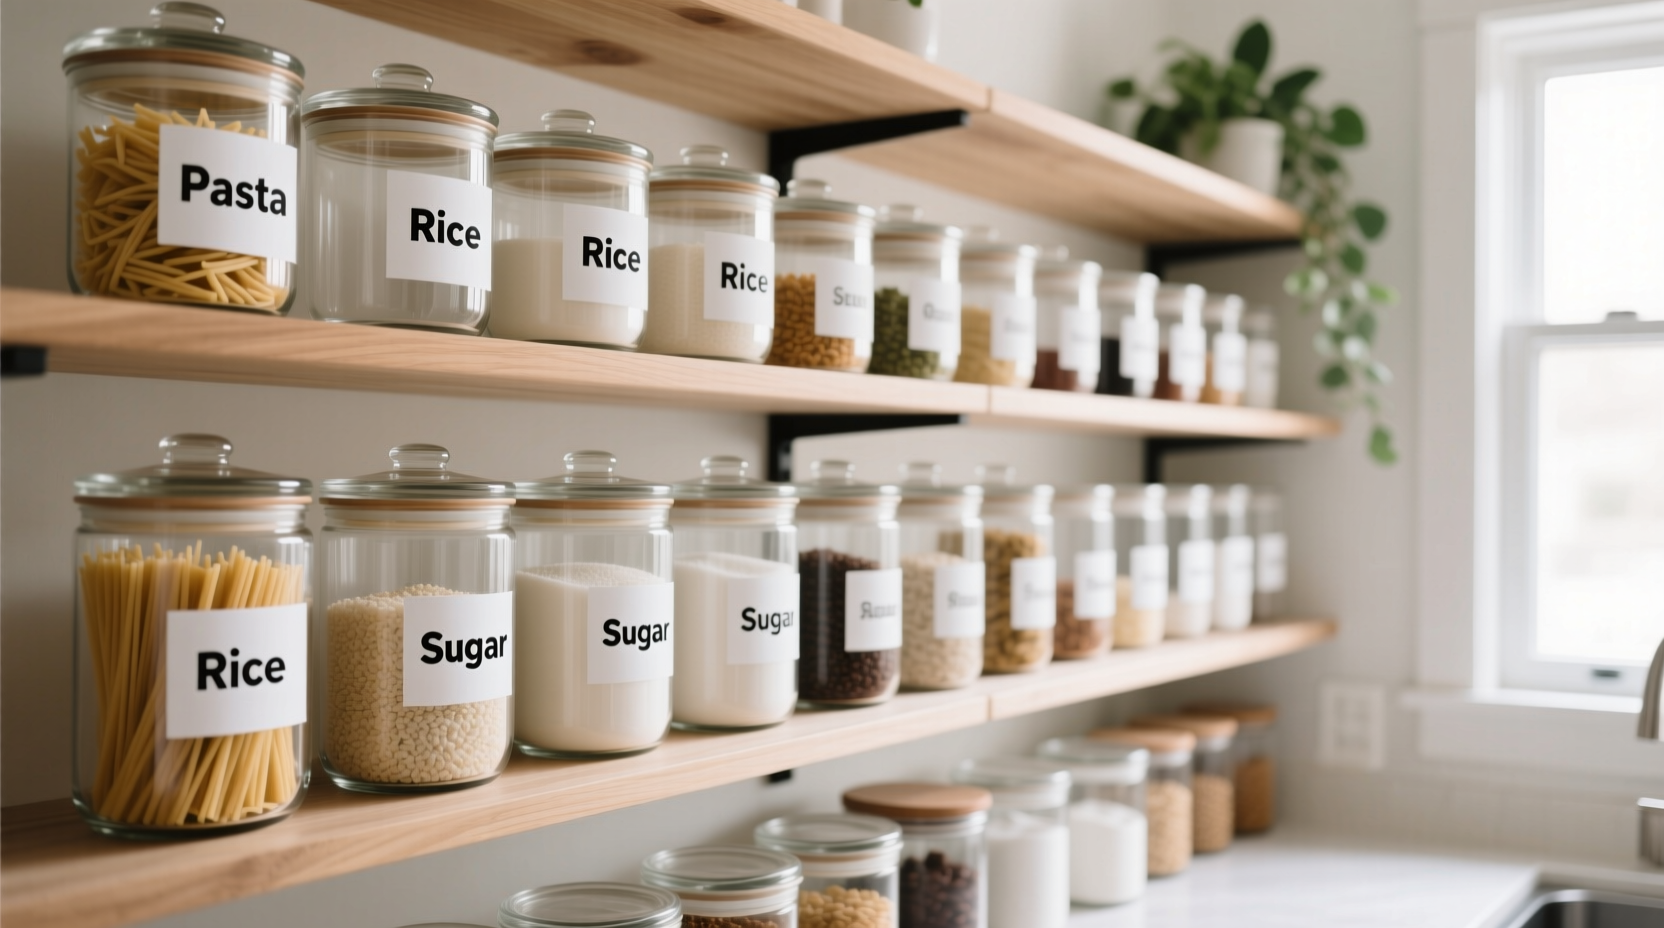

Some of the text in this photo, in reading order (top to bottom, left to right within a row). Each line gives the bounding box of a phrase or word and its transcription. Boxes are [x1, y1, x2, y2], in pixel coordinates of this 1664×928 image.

[180, 164, 287, 217] Pasta
[410, 207, 481, 250] Rice
[582, 235, 641, 273] Rice
[720, 261, 768, 293] Rice
[602, 618, 669, 651] Sugar
[741, 606, 794, 635] Sugar
[197, 647, 286, 691] Rice
[420, 630, 507, 670] Sugar
